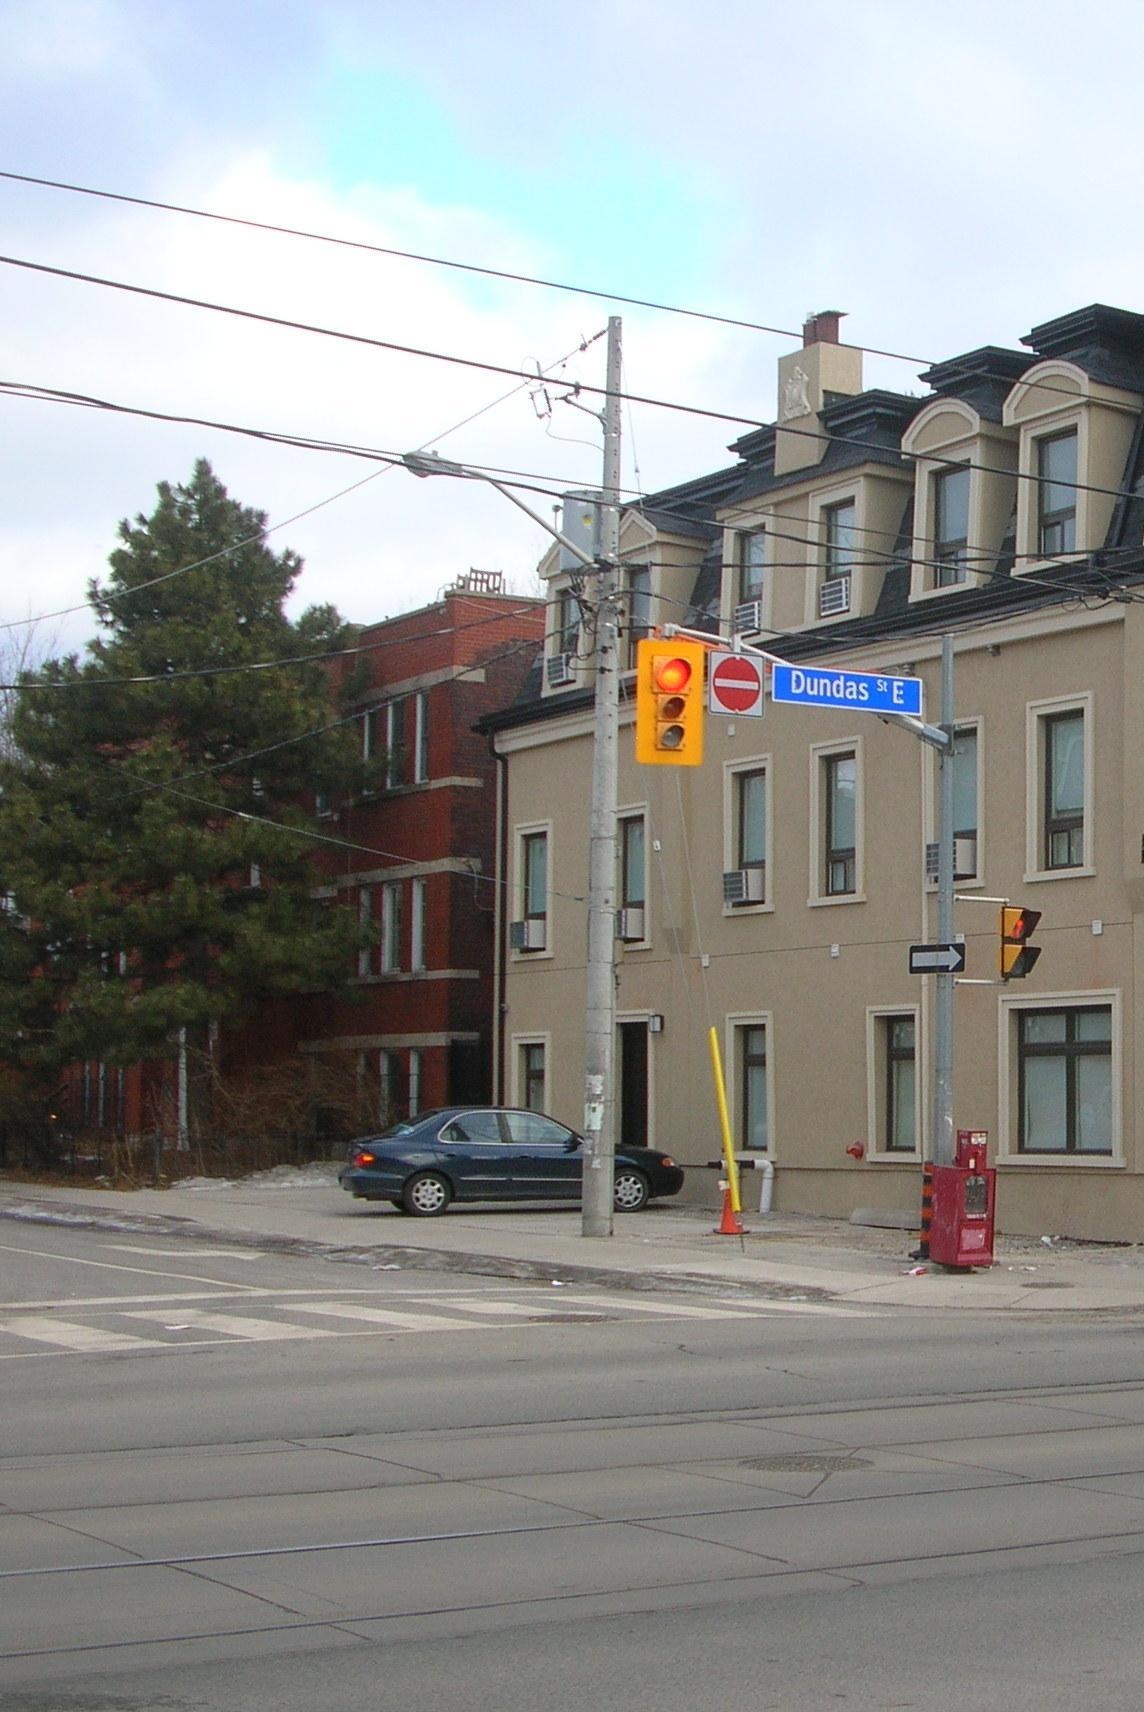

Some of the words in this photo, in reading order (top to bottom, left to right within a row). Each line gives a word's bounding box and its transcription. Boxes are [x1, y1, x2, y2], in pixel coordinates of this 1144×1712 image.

[790, 669, 870, 701] Dundas
[876, 679, 888, 692] St
[893, 681, 904, 704] E
